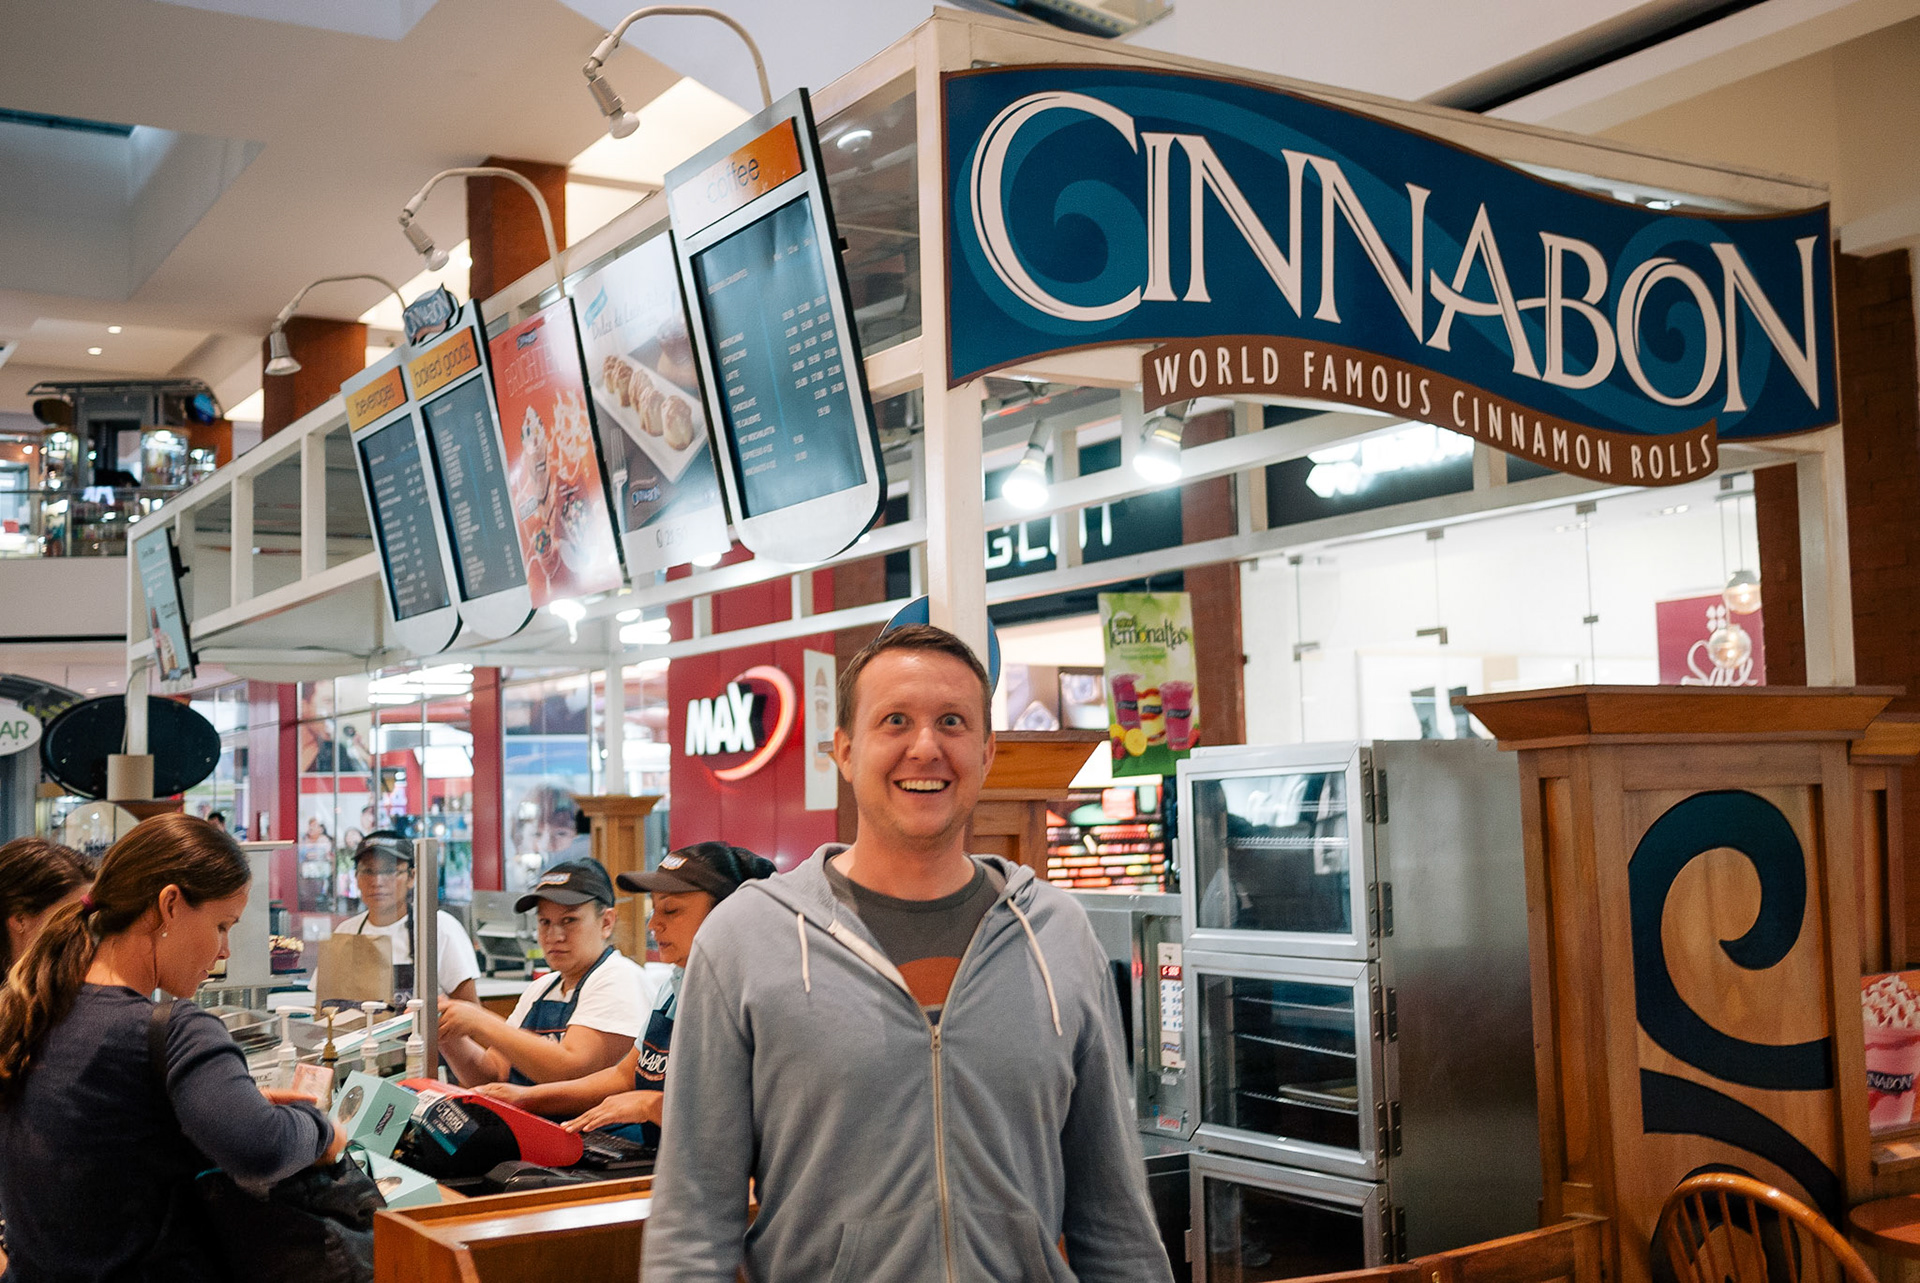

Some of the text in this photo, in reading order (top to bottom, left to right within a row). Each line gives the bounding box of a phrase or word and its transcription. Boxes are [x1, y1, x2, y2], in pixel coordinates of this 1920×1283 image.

[706, 158, 760, 203] coffee
[970, 90, 1819, 413] CINNABON
[413, 341, 472, 388] baked goods
[354, 382, 396, 417] beverages
[1154, 346, 1712, 480] WORLD FAMOUS CINNAMON ROLLS
[684, 681, 756, 757] MAX
